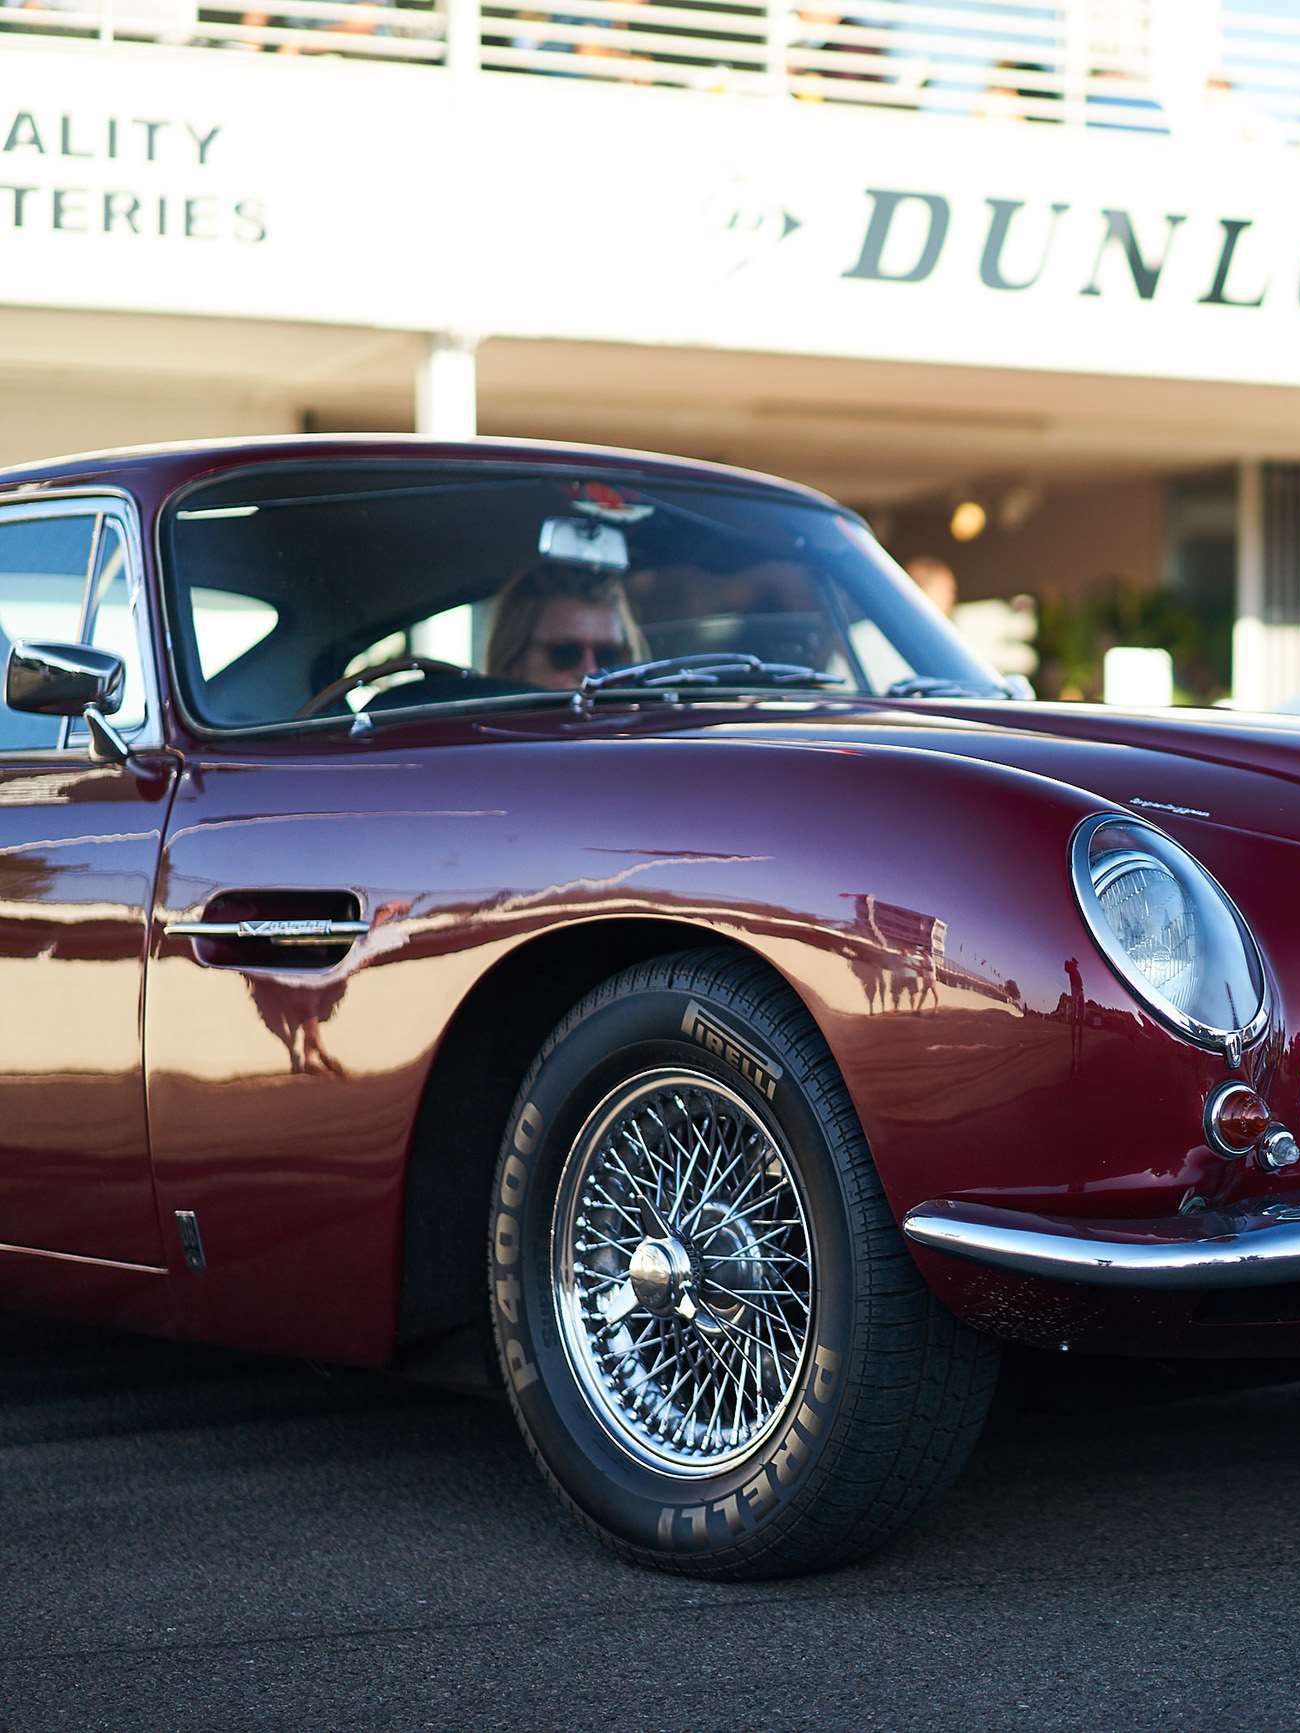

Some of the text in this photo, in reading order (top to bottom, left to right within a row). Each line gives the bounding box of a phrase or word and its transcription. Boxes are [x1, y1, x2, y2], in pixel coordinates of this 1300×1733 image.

[681, 999, 784, 1101] PIRELLI
[495, 1101, 544, 1392] P4000
[657, 1344, 843, 1546] PIRELLI
